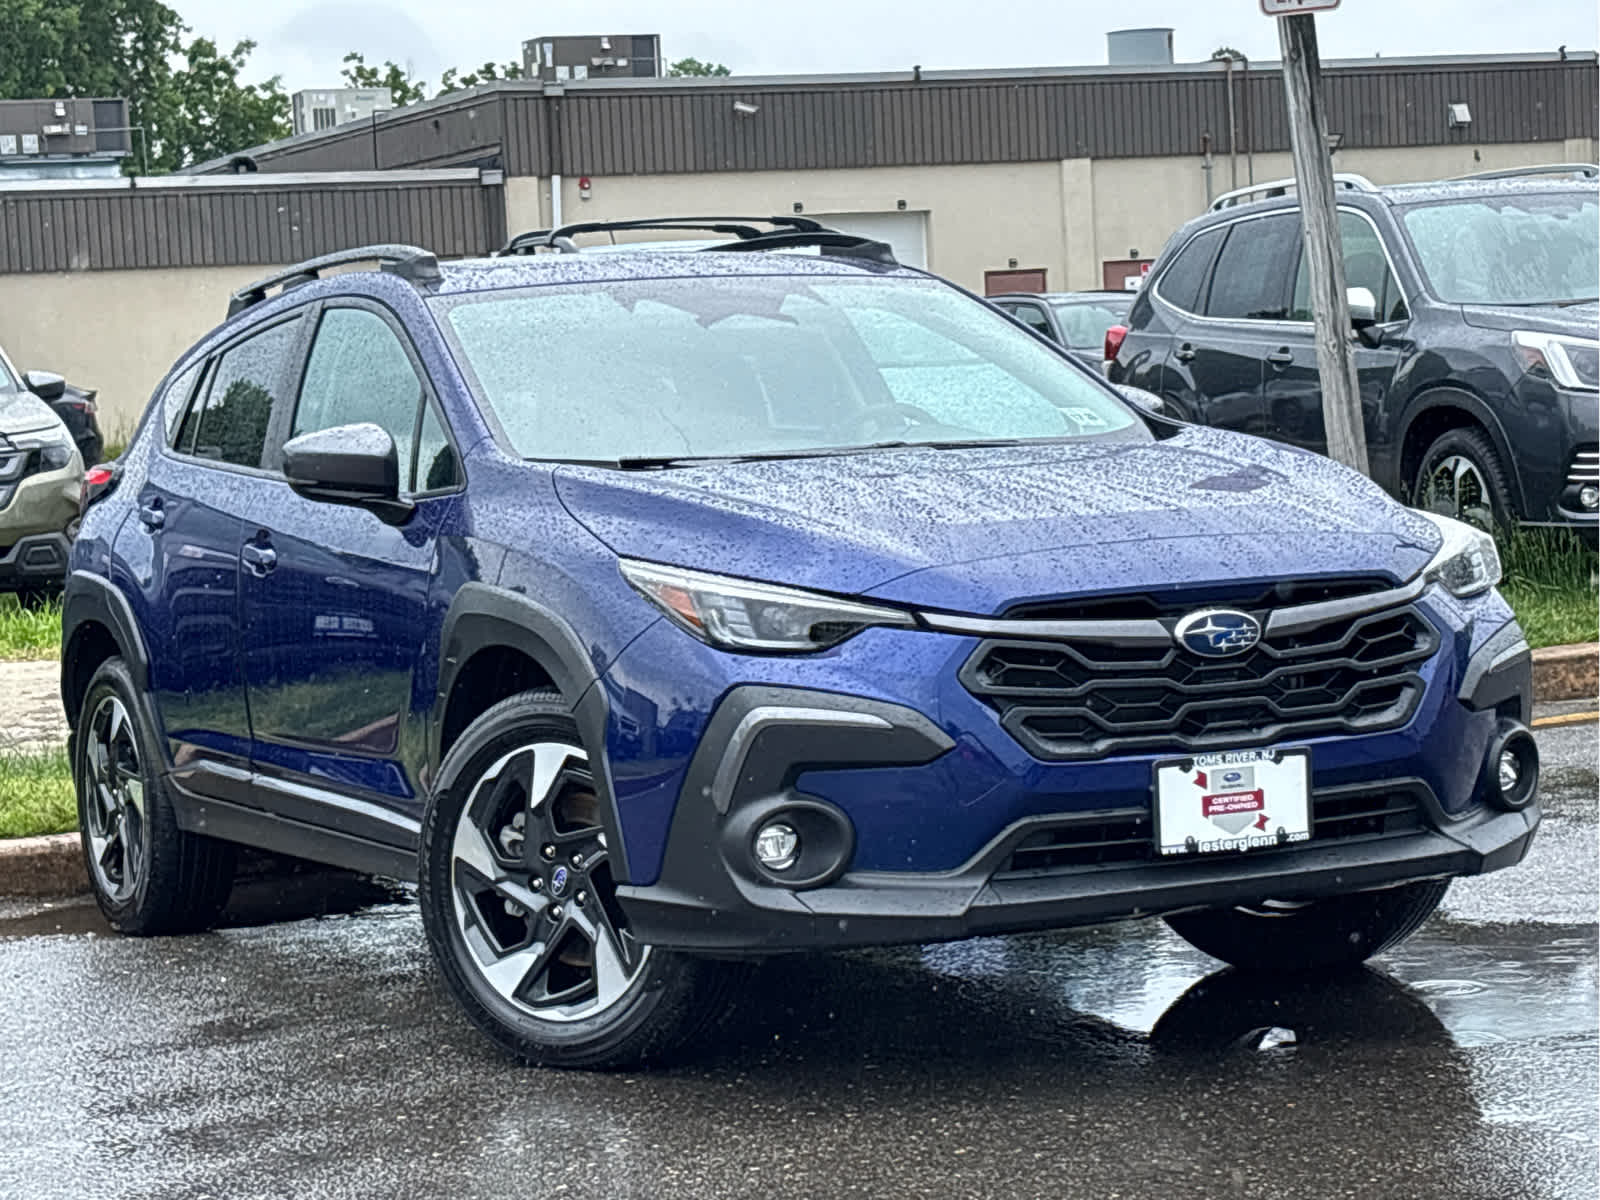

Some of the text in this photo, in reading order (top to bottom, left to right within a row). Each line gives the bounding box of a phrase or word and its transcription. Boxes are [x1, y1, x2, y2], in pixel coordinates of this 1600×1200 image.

[1193, 754, 1222, 767] TOMS
[1261, 749, 1276, 760] NJ
[1211, 794, 1255, 805] CERTIFIED
[1208, 801, 1258, 813] PRE-OWNED
